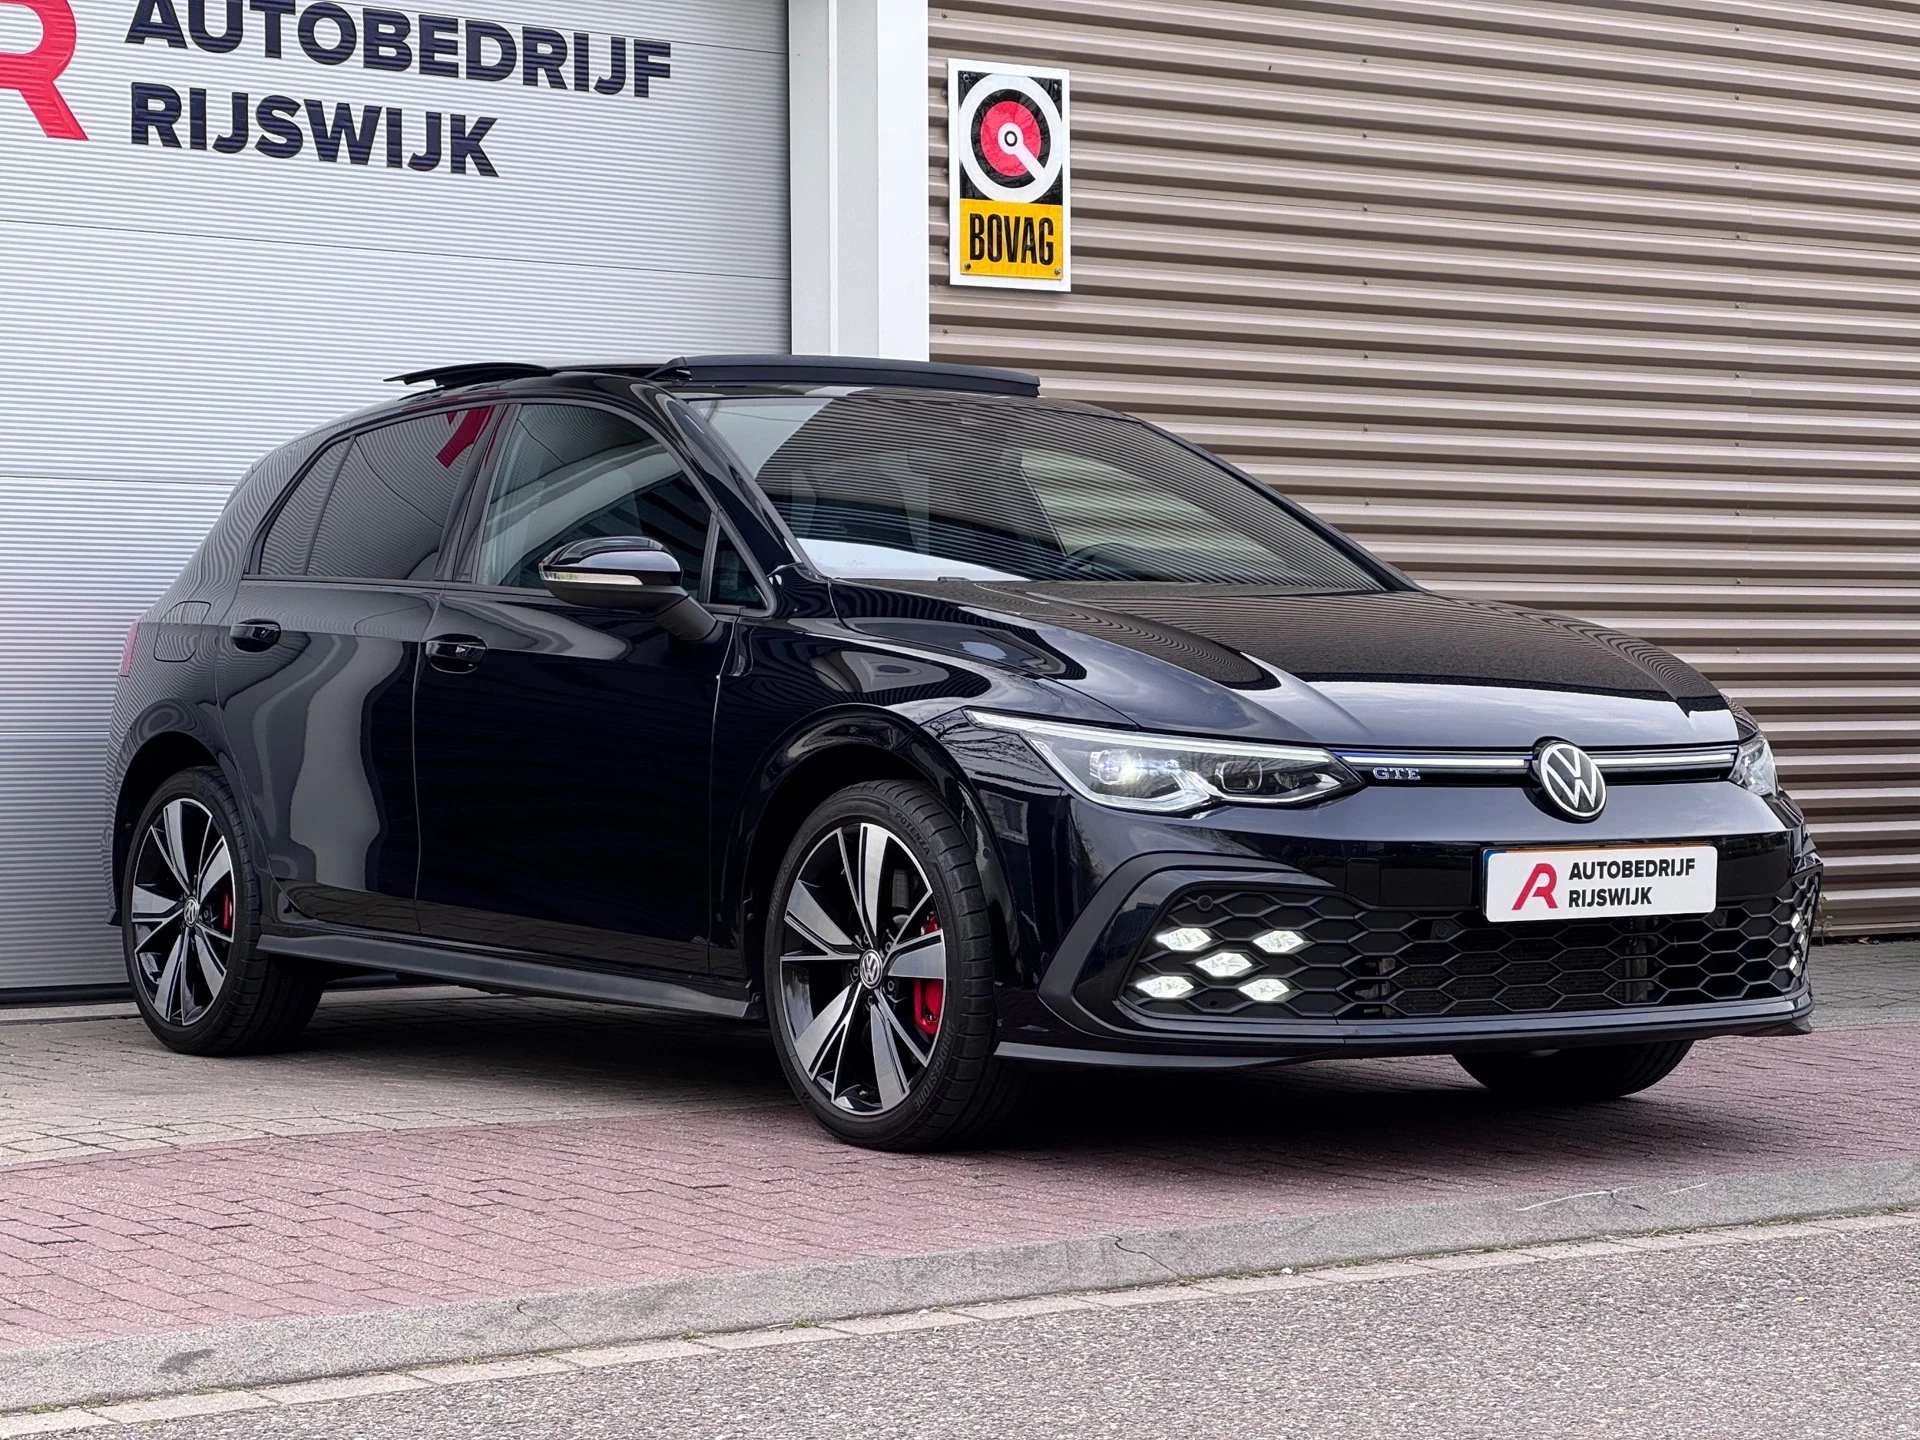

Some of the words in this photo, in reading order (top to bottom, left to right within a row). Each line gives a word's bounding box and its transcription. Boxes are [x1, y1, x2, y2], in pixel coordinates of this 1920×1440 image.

[124, 0, 672, 98] AUTOBEDRIJF
[131, 81, 500, 178] RIJSWIJK
[969, 213, 1054, 266] BOVAG
[1372, 766, 1421, 781] GTE
[895, 811, 931, 856] POTENZA
[1568, 858, 1696, 880] AUTOBEDRIJF
[1568, 886, 1653, 908] RIJSWIJK
